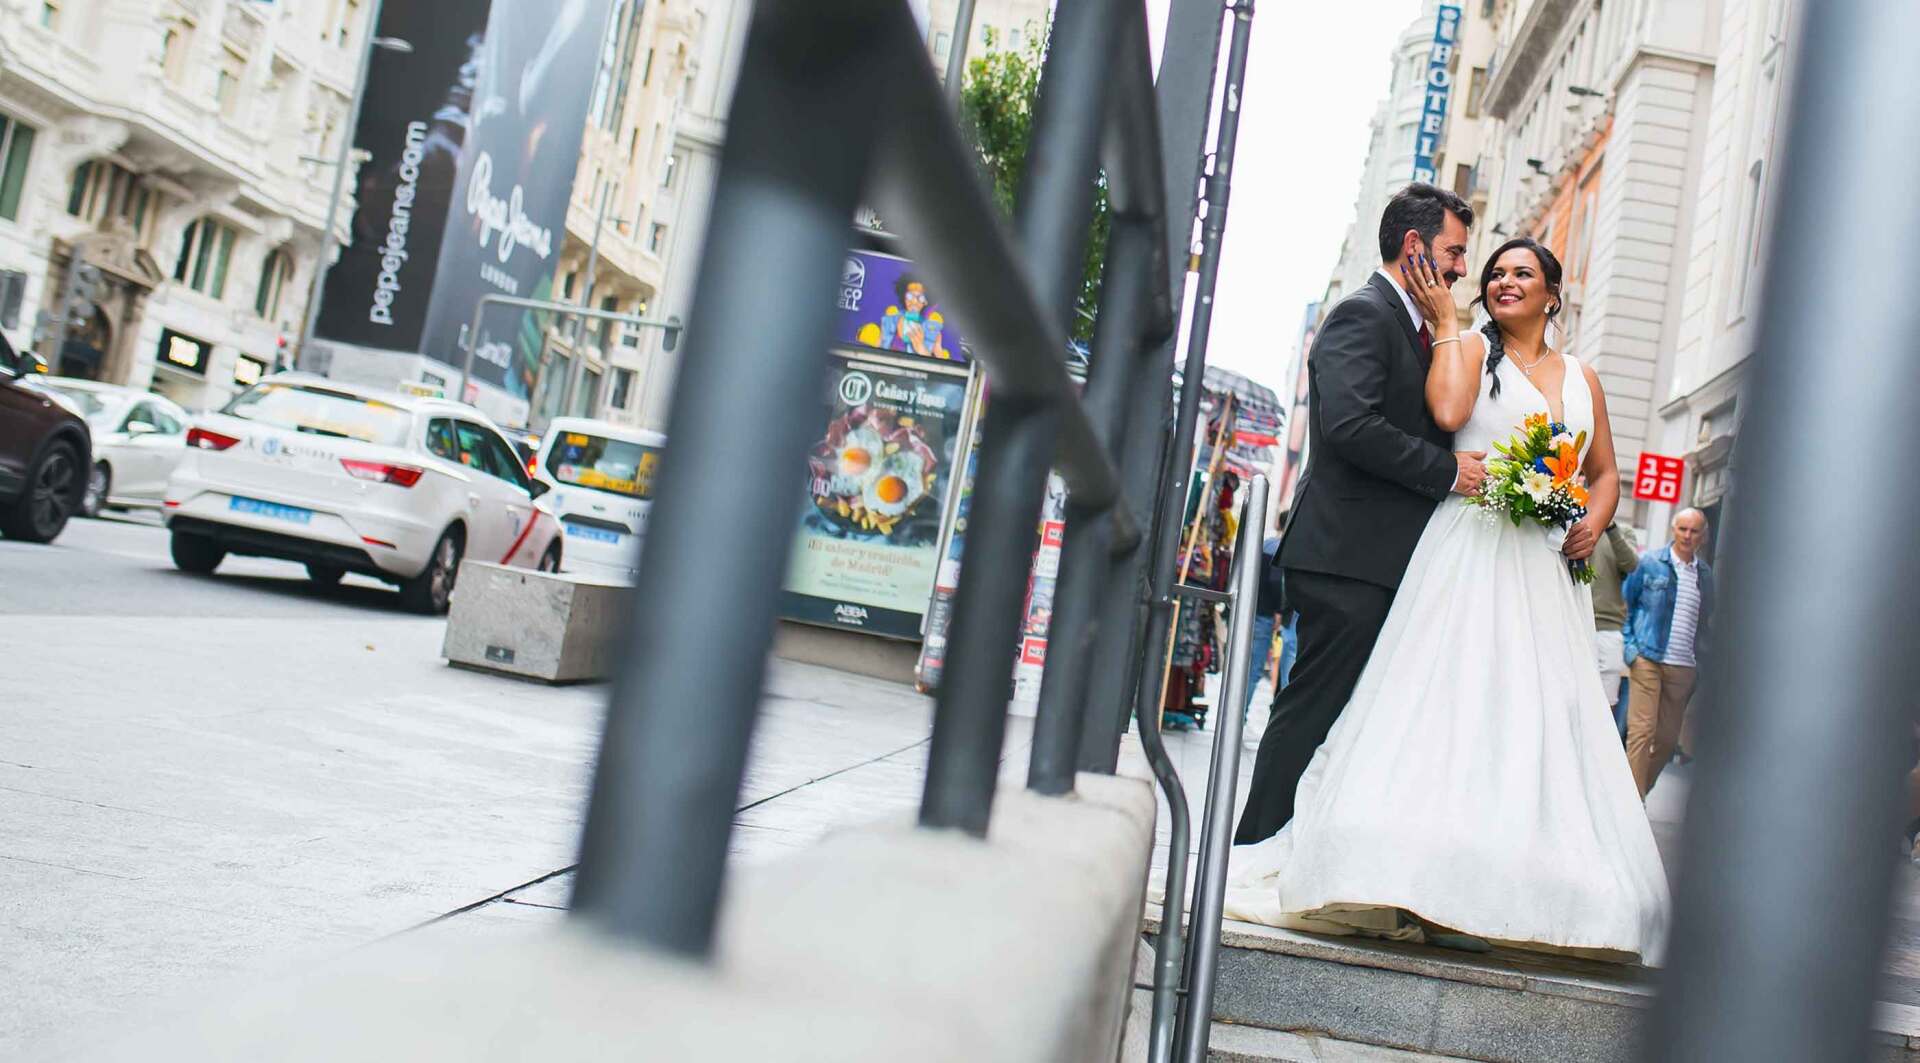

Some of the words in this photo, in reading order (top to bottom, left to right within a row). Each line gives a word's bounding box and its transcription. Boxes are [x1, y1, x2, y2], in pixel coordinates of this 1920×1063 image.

[1420, 43, 1453, 158] HOTEL
[370, 121, 428, 325] pepejeans.com
[498, 184, 552, 263] Jeans
